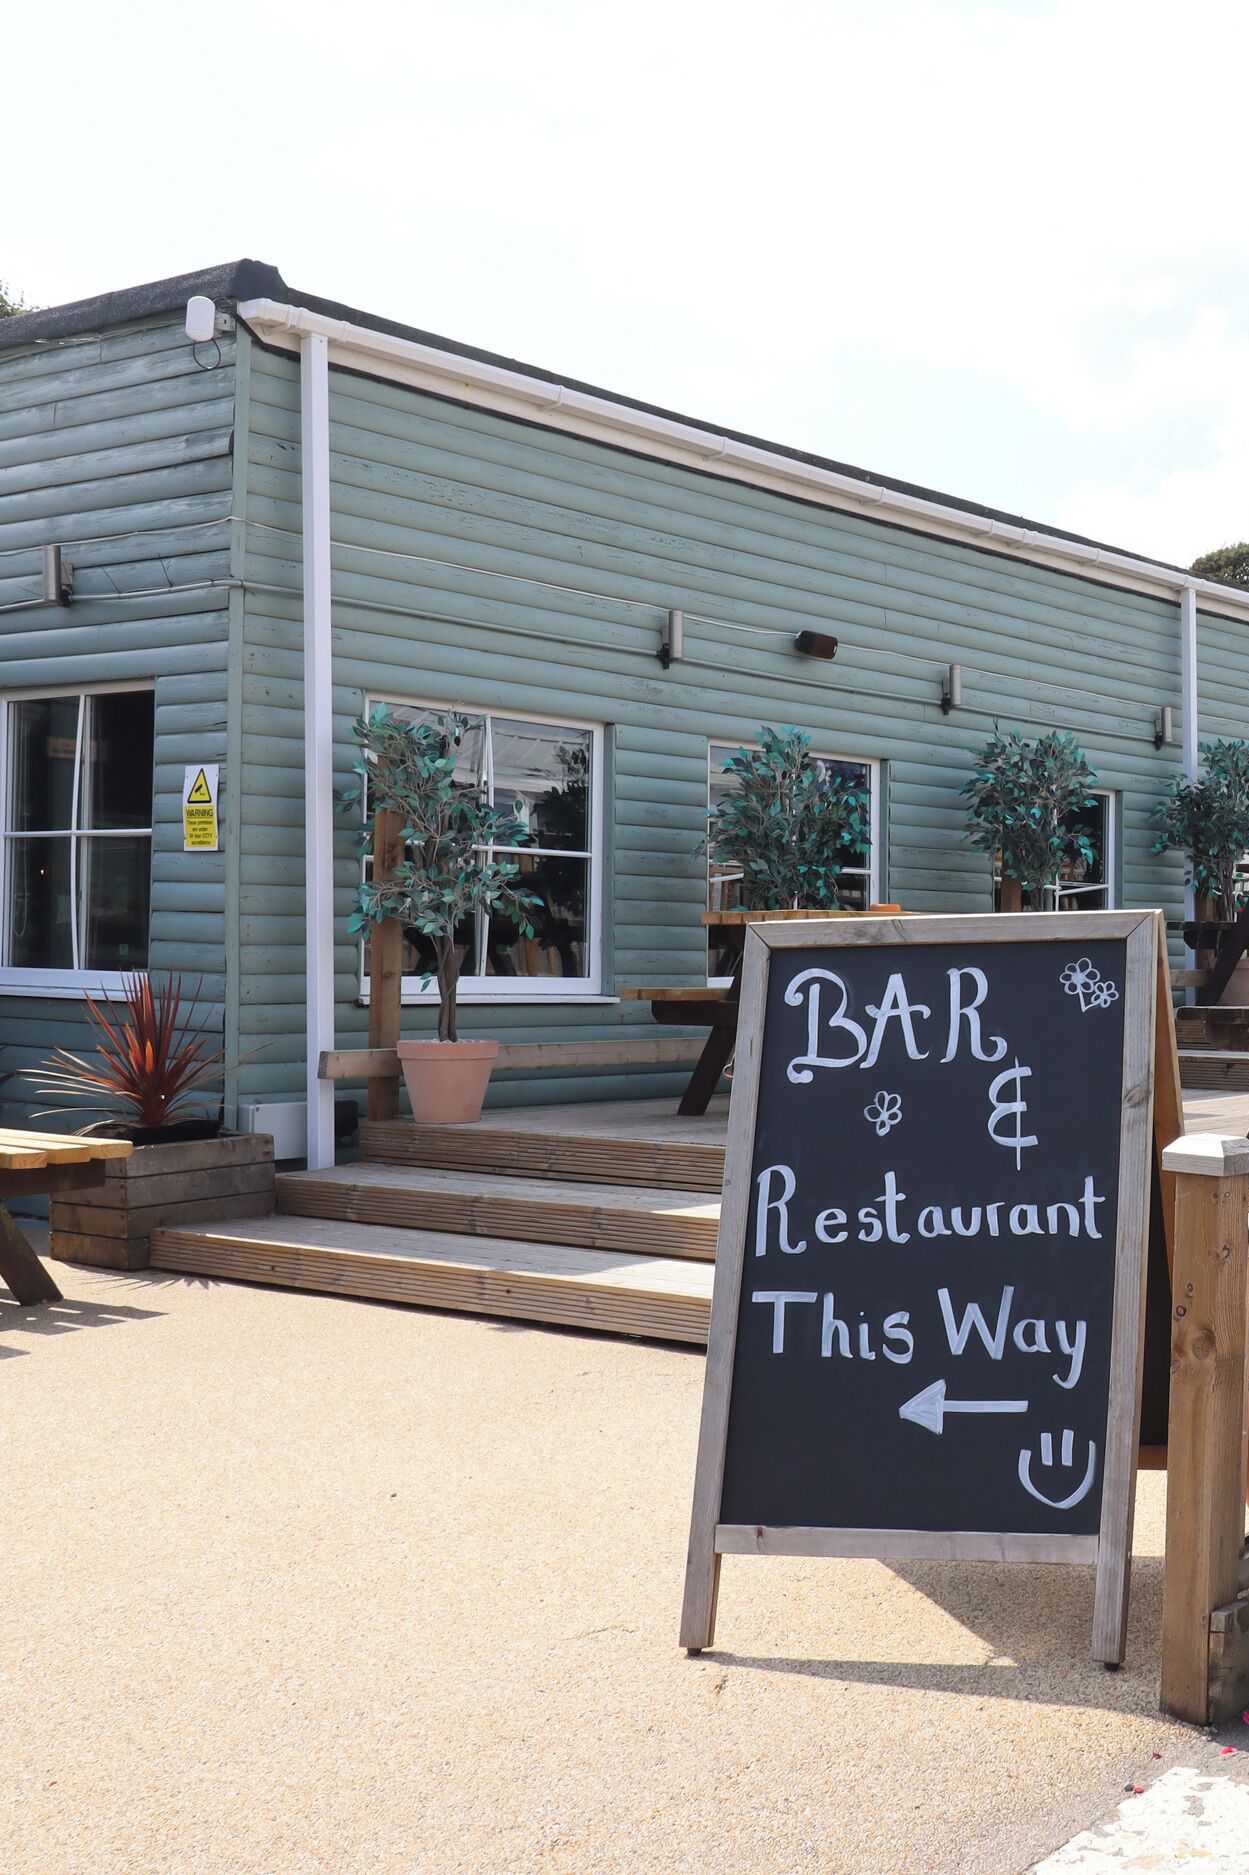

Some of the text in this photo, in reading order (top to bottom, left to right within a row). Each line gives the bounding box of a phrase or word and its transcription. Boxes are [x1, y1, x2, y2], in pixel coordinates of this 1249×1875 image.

[186, 808, 214, 817] WARNING
[785, 967, 1007, 1083] BAR
[988, 1057, 1038, 1170] &
[755, 1165, 1105, 1257] Restaurant
[752, 1285, 1087, 1389] This Way
